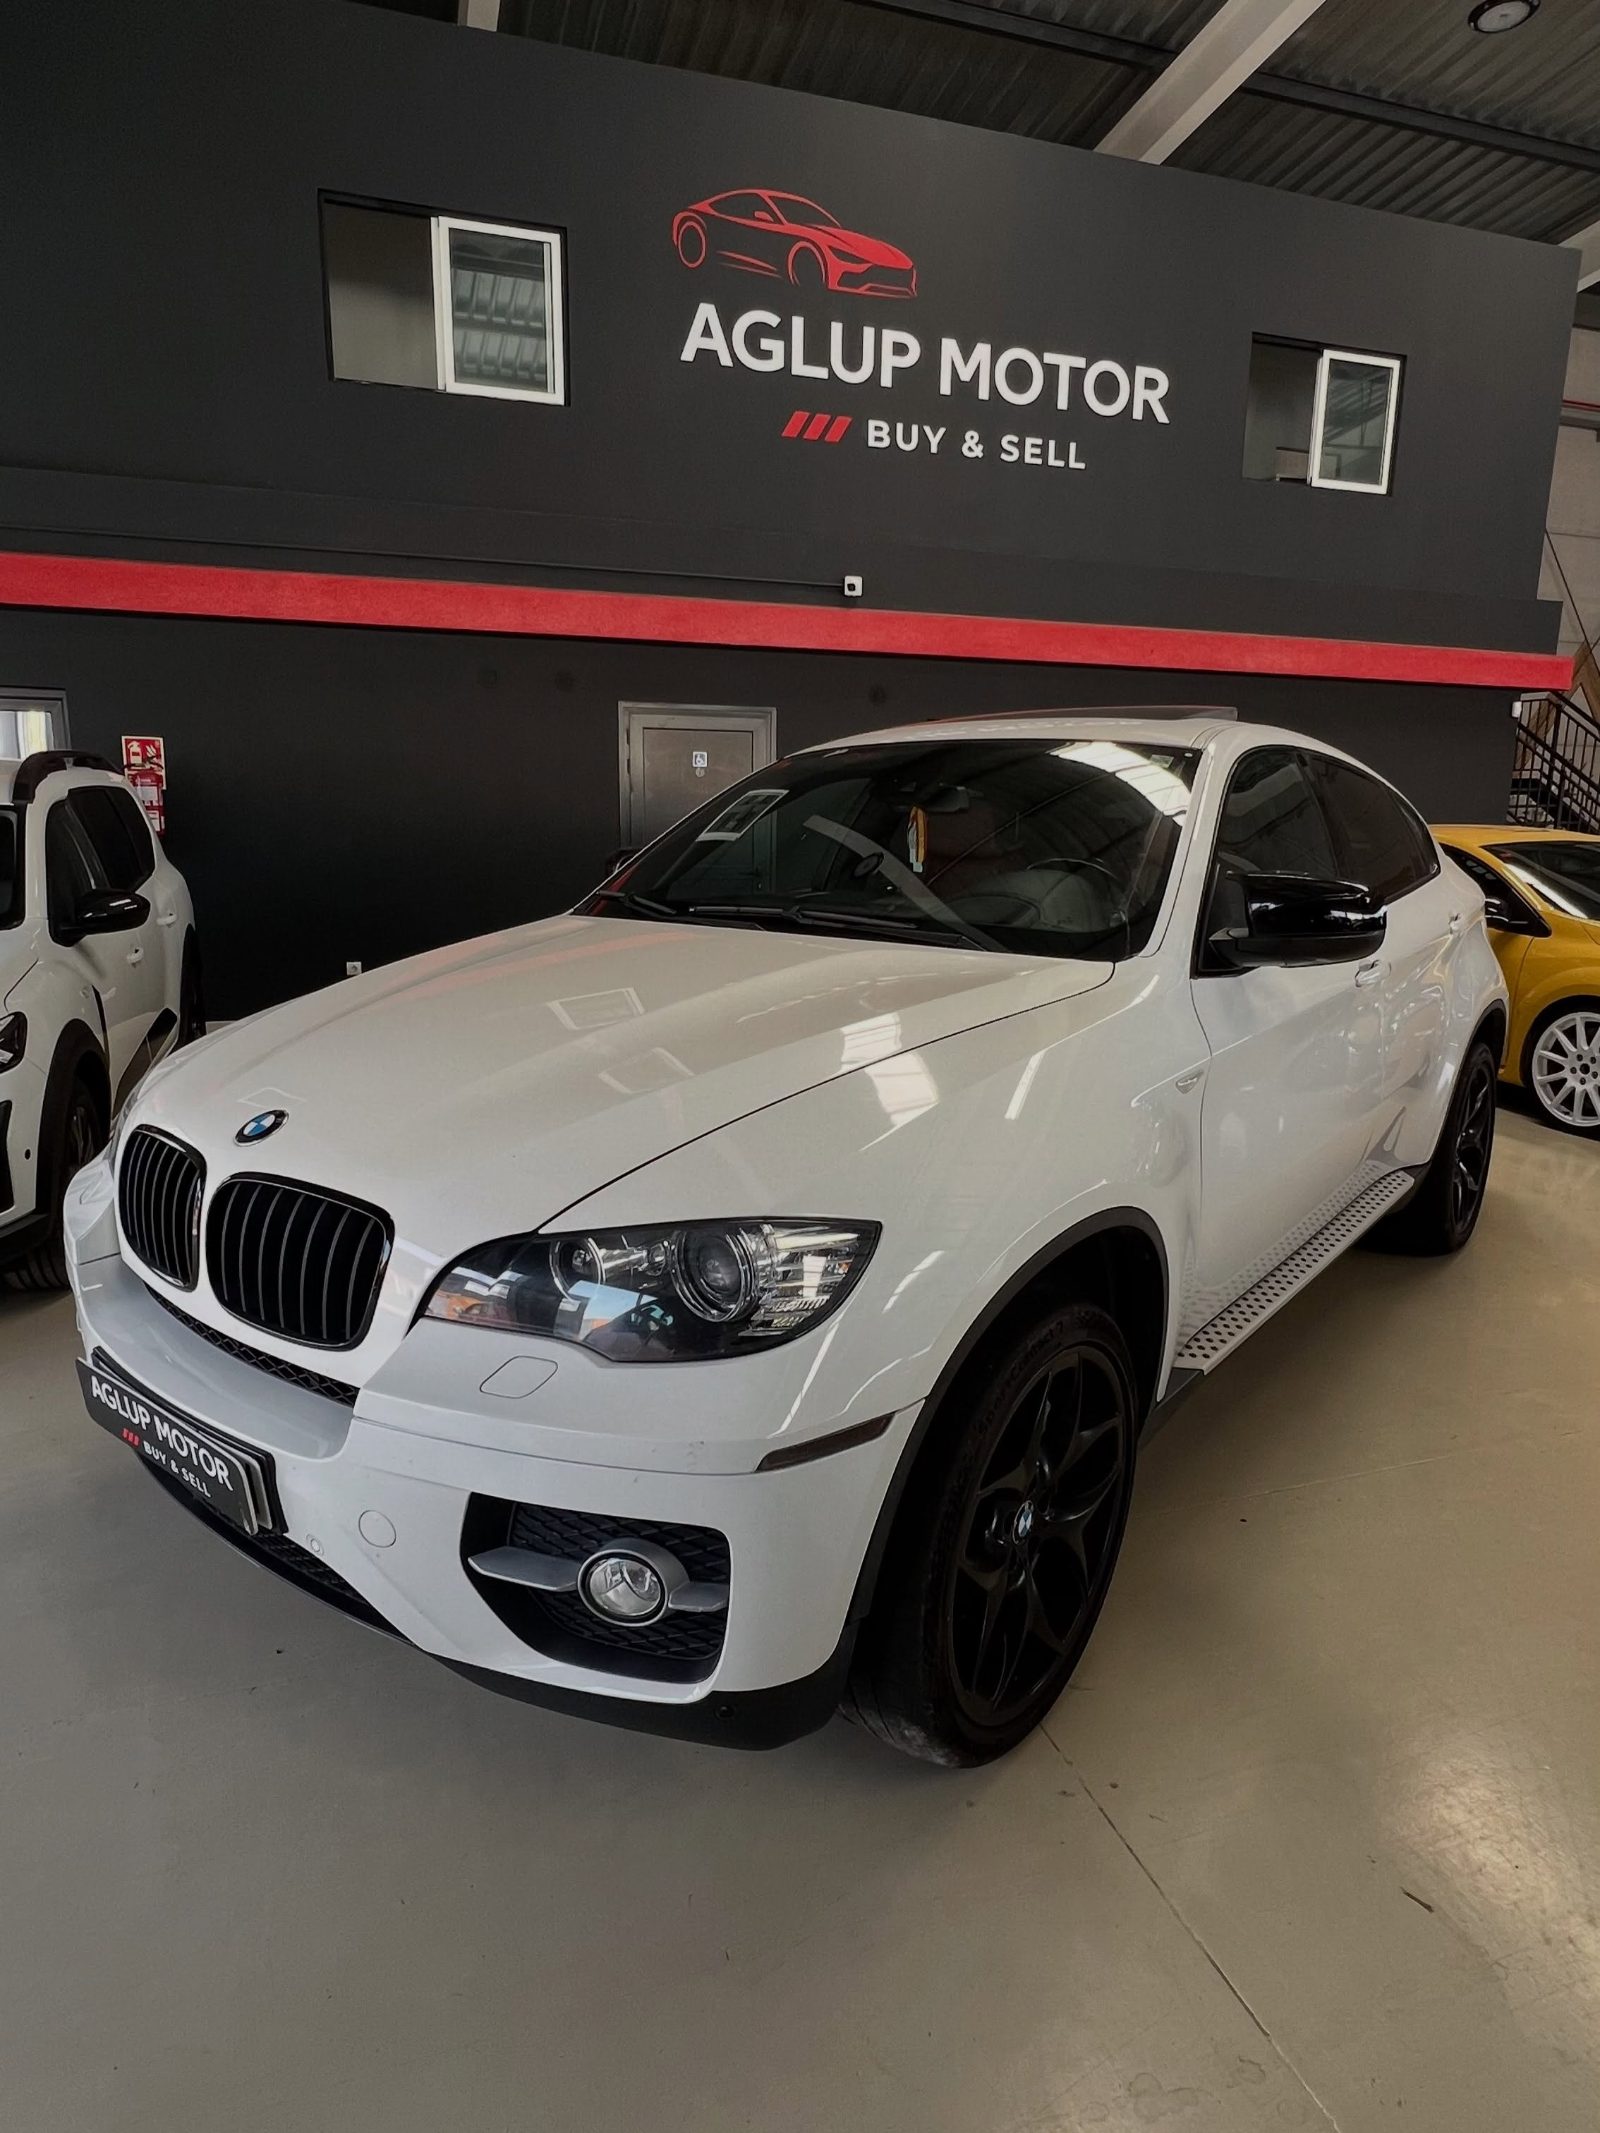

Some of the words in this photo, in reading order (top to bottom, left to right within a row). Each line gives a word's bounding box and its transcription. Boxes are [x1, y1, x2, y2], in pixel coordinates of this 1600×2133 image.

[680, 302, 921, 388] AGLUP
[939, 337, 1170, 424] MOTOR
[867, 419, 947, 454] BUY
[961, 430, 984, 459] &
[1000, 434, 1086, 470] SELL
[90, 1375, 151, 1430] AGLUP
[153, 1415, 234, 1491] MOTOR
[143, 1440, 168, 1466] BUY
[170, 1459, 179, 1474] &
[181, 1467, 212, 1498] SELL
